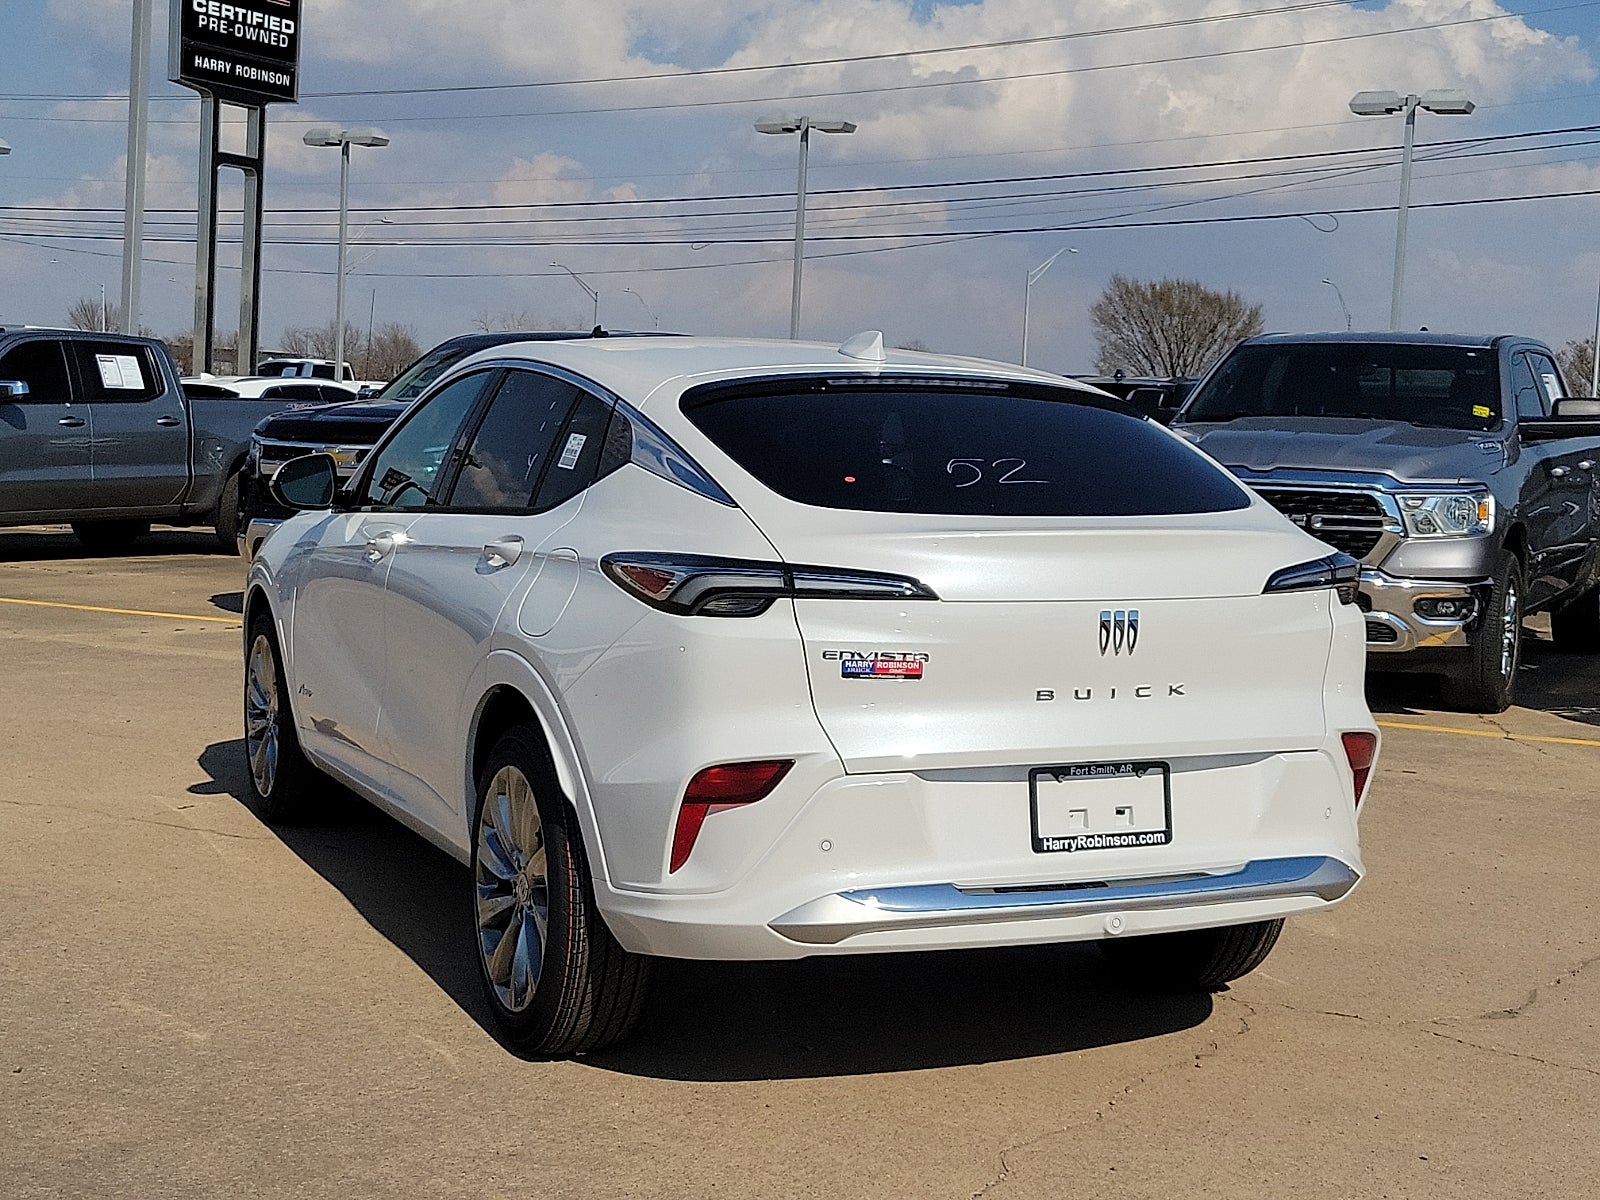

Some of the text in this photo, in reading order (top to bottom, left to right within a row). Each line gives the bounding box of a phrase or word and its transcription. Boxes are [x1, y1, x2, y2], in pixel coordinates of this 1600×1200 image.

[193, 0, 294, 34] CERTIFIED
[199, 15, 289, 48] PRE-OWNED
[194, 55, 290, 87] HARRY ROBINSON
[947, 458, 1050, 488] 52
[1036, 684, 1185, 701] BUICK
[1070, 764, 1133, 776] Fort Smith, AR
[1043, 833, 1165, 852] HarryRobinson.com
